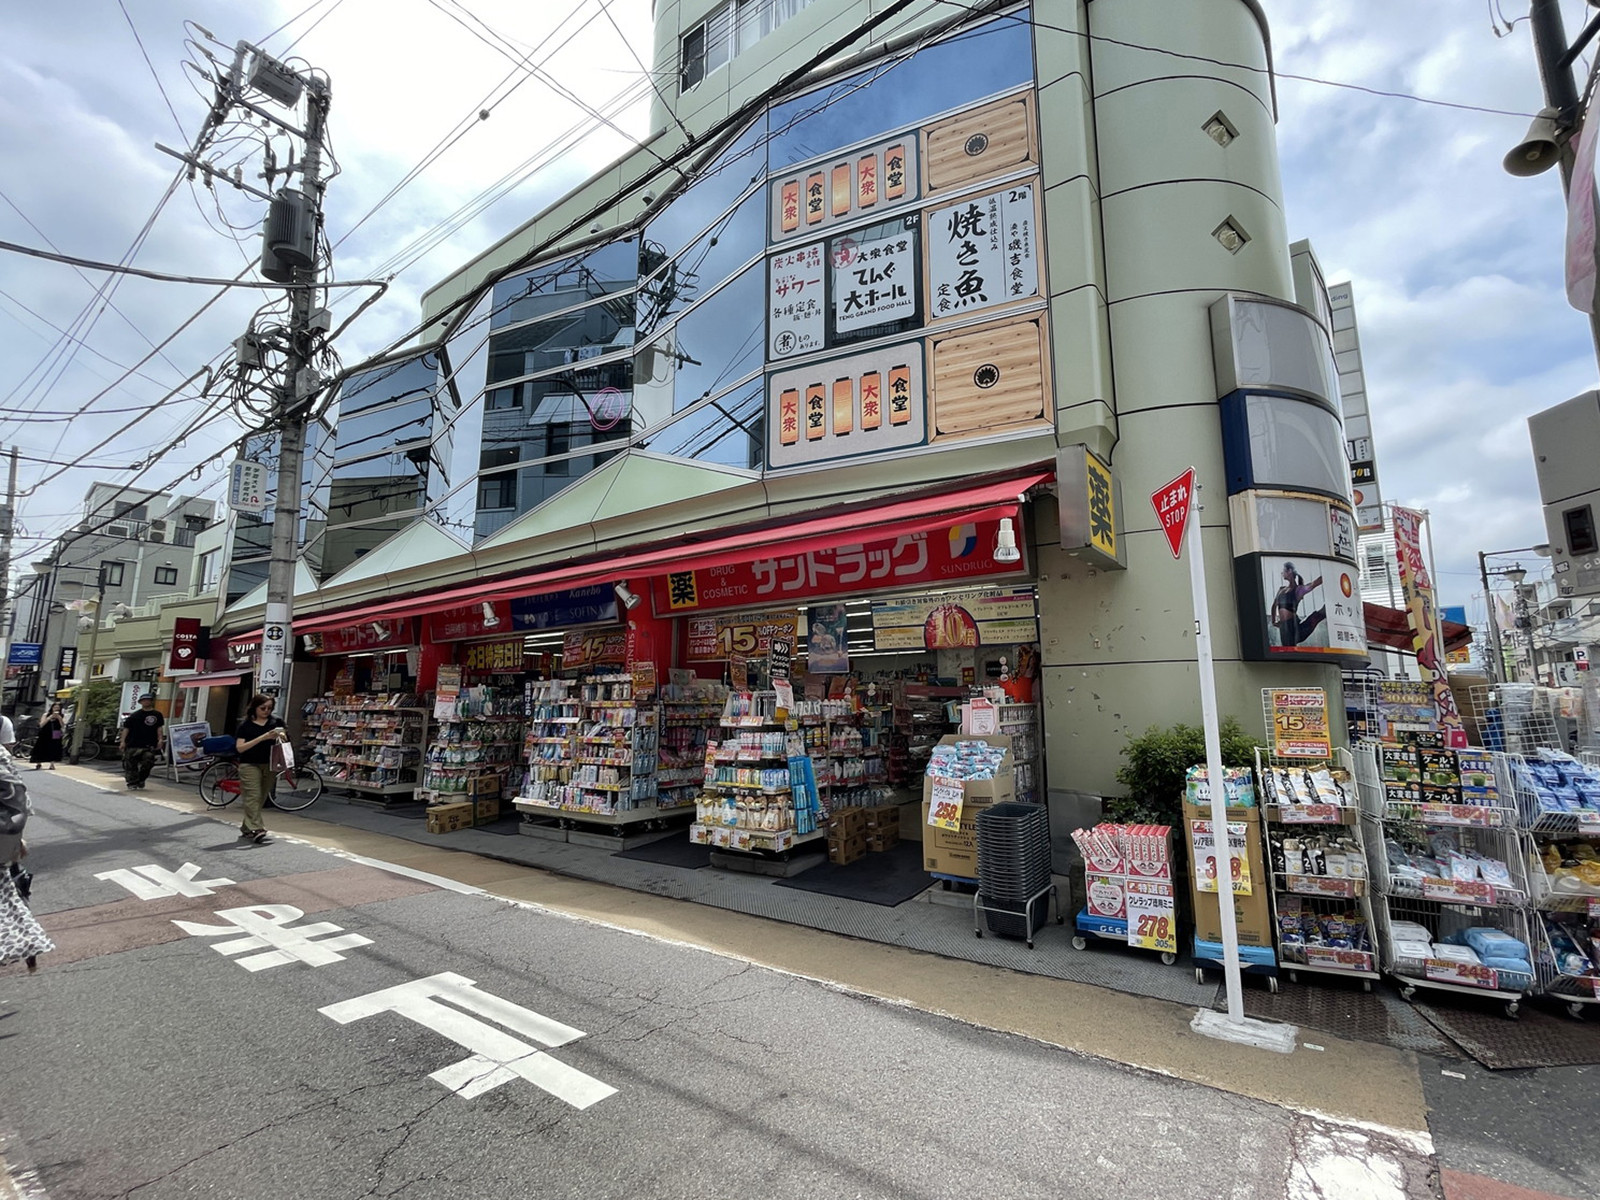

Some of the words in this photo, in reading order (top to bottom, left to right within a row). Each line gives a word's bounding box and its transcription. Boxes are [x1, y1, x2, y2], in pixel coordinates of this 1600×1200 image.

[860, 165, 876, 196] 大衆
[887, 156, 903, 189] 食堂
[783, 190, 798, 221] 大衆
[808, 182, 823, 214] 食堂
[1008, 190, 1028, 204] 2階
[905, 214, 920, 226] 2F
[857, 240, 909, 264] 大衆食堂
[947, 203, 989, 309] 焼き魚
[852, 261, 896, 287] てんぐ
[775, 278, 821, 299] サワー
[843, 283, 907, 314] 大ホール
[937, 283, 951, 312] 定食
[773, 299, 816, 319] 各種定食
[856, 307, 877, 318] GRAND
[877, 302, 896, 312] FOOD
[896, 299, 912, 308] HALL
[779, 334, 793, 352] 煮
[863, 384, 879, 417] 大衆
[891, 377, 908, 412] 食堂
[782, 401, 797, 432] 大衆
[808, 394, 823, 429] 食堂
[1088, 464, 1113, 548] 薬
[1160, 484, 1188, 513] 止まれ
[1165, 506, 1185, 528] STOP
[709, 564, 736, 577] DRUG
[752, 531, 929, 595] サンドラッグ
[940, 559, 993, 575] SUNDRUG
[670, 571, 696, 605] 薬
[702, 584, 749, 600] COSMETIC
[720, 578, 727, 587] &
[1576, 651, 1585, 660] P
[130, 684, 141, 711] docomo
[1276, 715, 1305, 731] 15
[1422, 755, 1449, 764] ケール
[934, 801, 958, 822] 258
[1305, 804, 1333, 817] 398
[1205, 855, 1242, 881] 38
[1136, 914, 1169, 940] 278
[1154, 939, 1169, 948] 305
